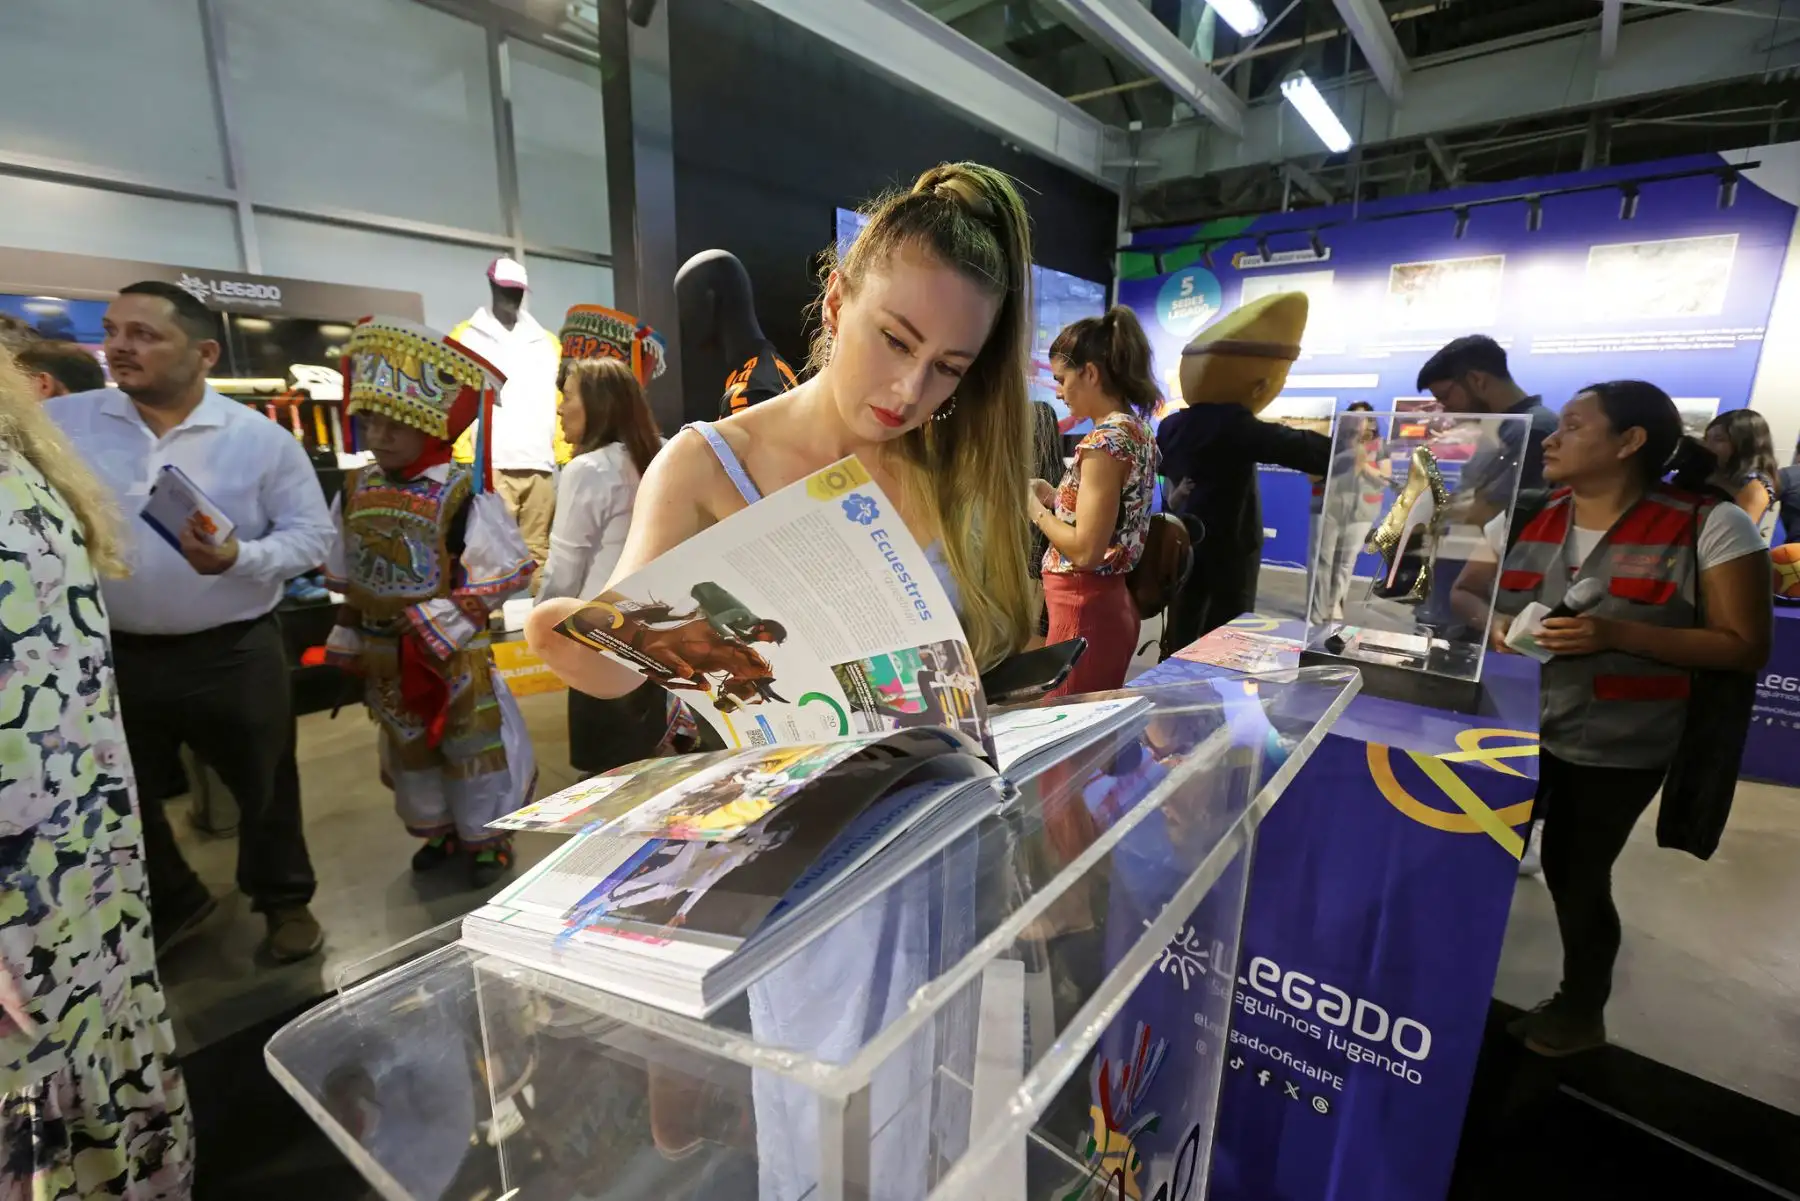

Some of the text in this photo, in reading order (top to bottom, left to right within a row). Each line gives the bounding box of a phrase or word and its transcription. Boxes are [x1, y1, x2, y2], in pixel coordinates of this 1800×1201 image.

[1171, 294, 1205, 311] SEDES
[1181, 275, 1195, 297] 5
[870, 529, 932, 621] Ecuestres
[1327, 1030, 1422, 1085] jugando
